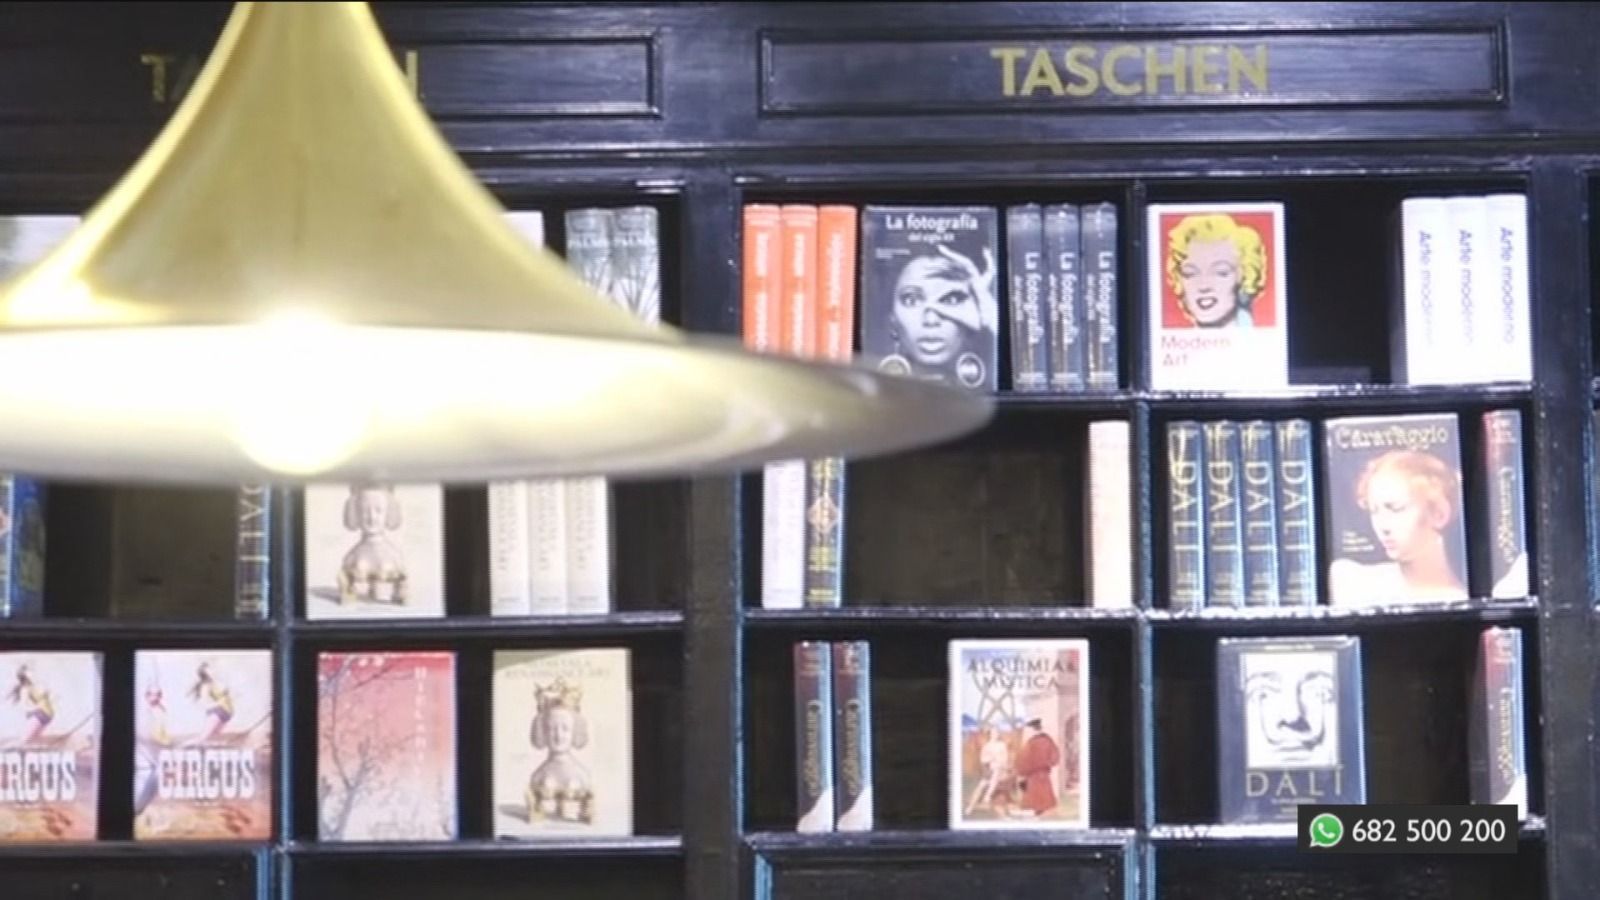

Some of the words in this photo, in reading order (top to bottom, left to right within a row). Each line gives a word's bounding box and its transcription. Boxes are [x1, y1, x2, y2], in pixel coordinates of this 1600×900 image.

[990, 43, 1268, 97] TASCHEN
[885, 213, 903, 230] La
[1500, 226, 1514, 262] Arte
[158, 749, 257, 800] CIRCUS
